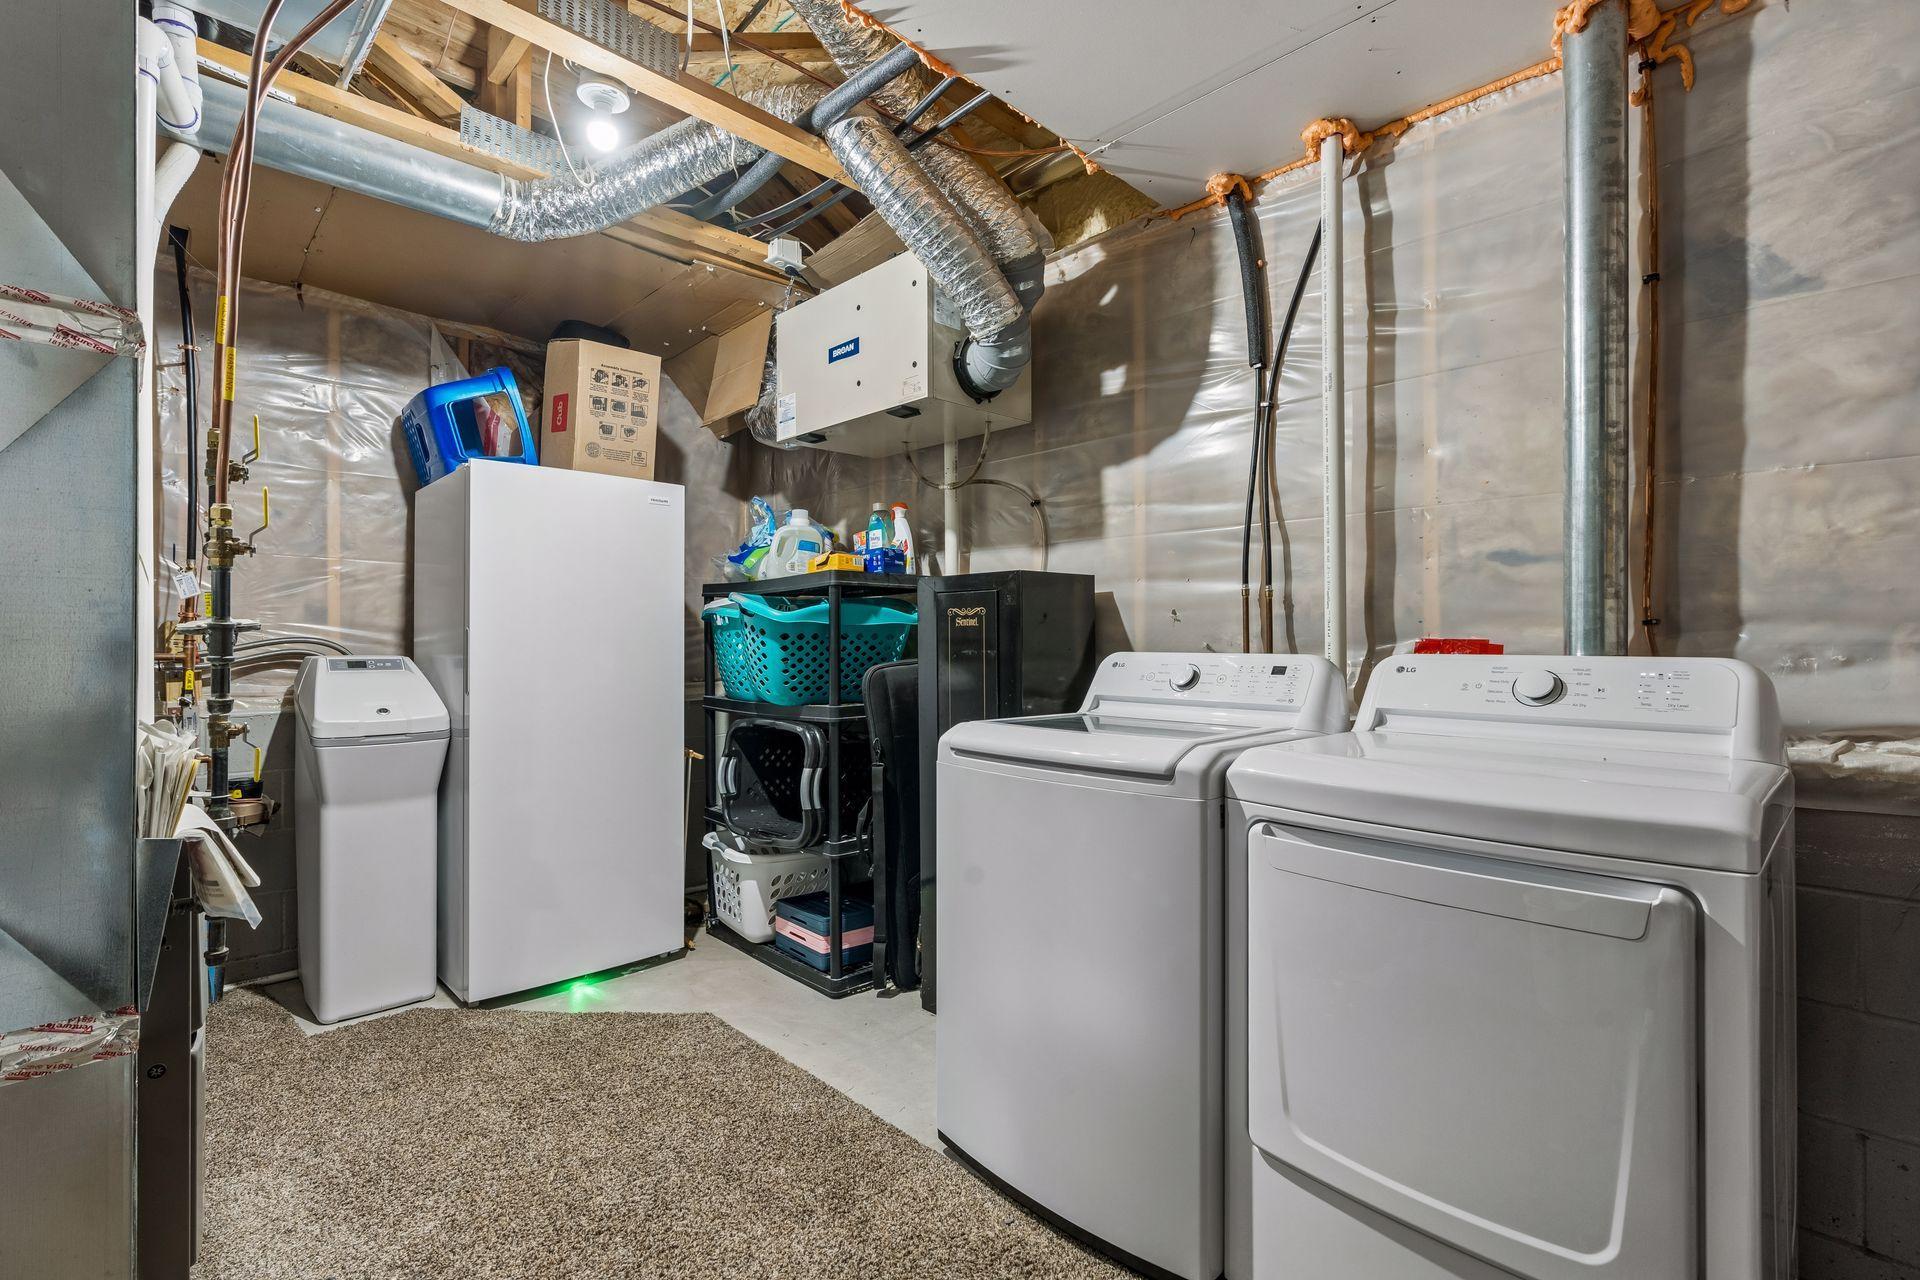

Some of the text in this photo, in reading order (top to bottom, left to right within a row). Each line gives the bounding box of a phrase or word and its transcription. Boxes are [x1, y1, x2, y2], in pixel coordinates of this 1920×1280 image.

[0, 309, 33, 328] EATHER
[832, 342, 855, 358] BROAN
[956, 617, 978, 627] Sentinel
